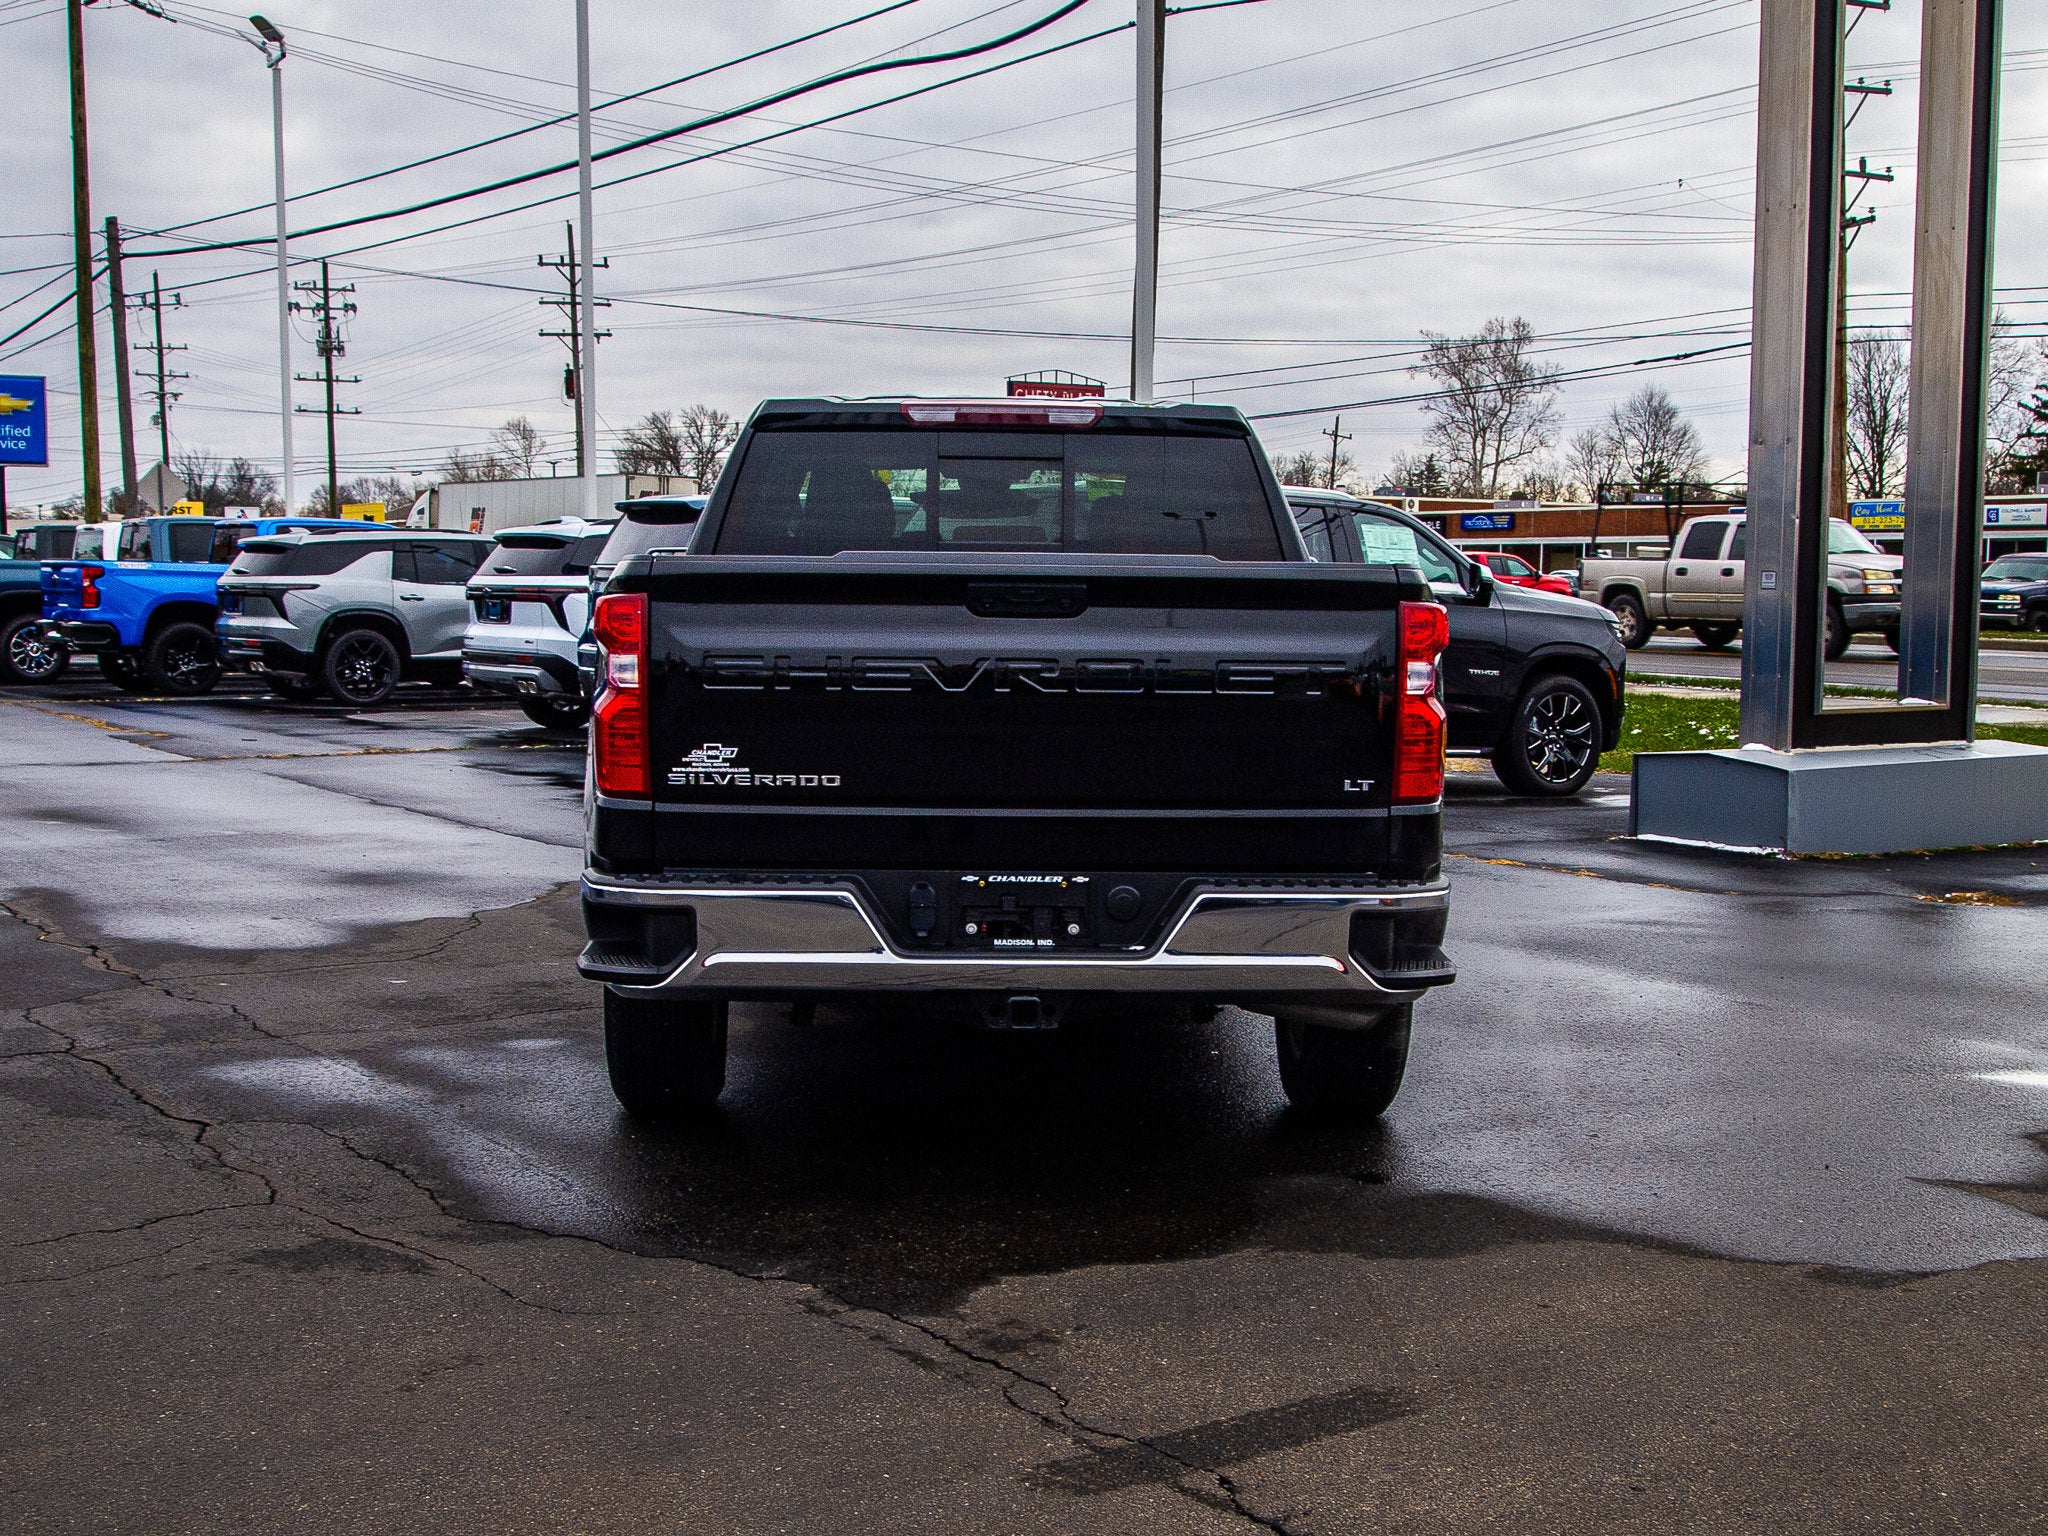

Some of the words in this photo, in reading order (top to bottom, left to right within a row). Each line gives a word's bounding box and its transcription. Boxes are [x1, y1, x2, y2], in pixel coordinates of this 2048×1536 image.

[703, 655, 1346, 695] CHEVROLET
[1468, 668, 1500, 676] TAHOE
[691, 749, 732, 757] CHANDLER
[667, 773, 840, 787] SILVERADO
[1343, 779, 1375, 791] LT
[988, 875, 1063, 883] CHANDLER
